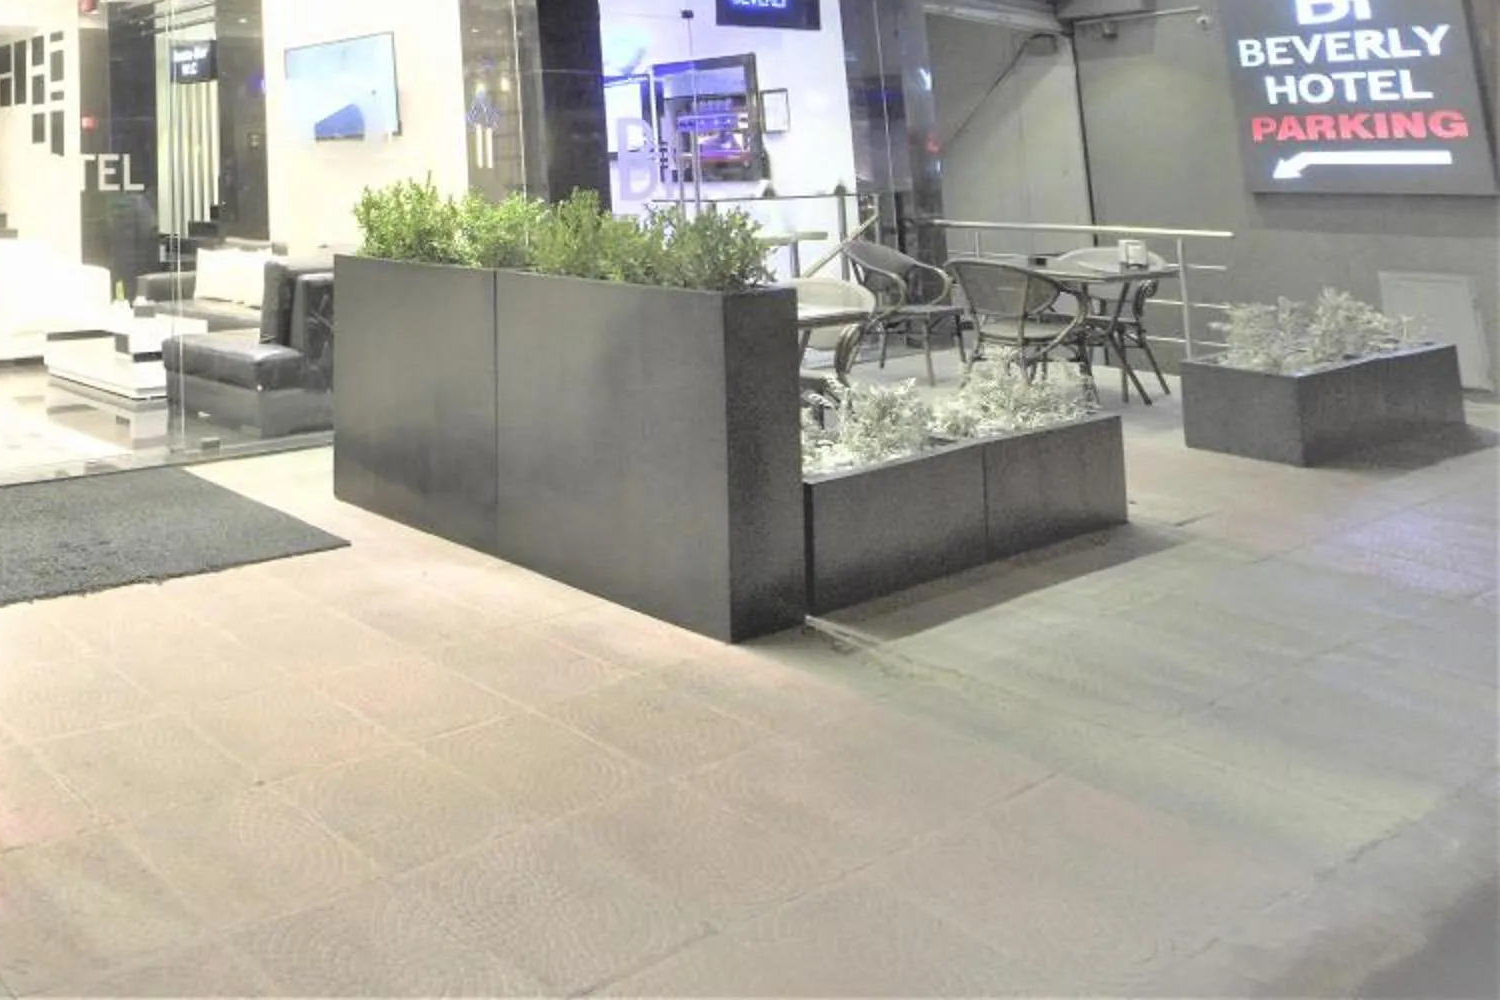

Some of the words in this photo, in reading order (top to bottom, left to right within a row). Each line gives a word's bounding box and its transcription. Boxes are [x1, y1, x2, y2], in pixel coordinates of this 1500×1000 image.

[1237, 24, 1450, 68] BEVERLY
[1264, 69, 1434, 105] HOTEL
[1251, 111, 1469, 142] PARKING
